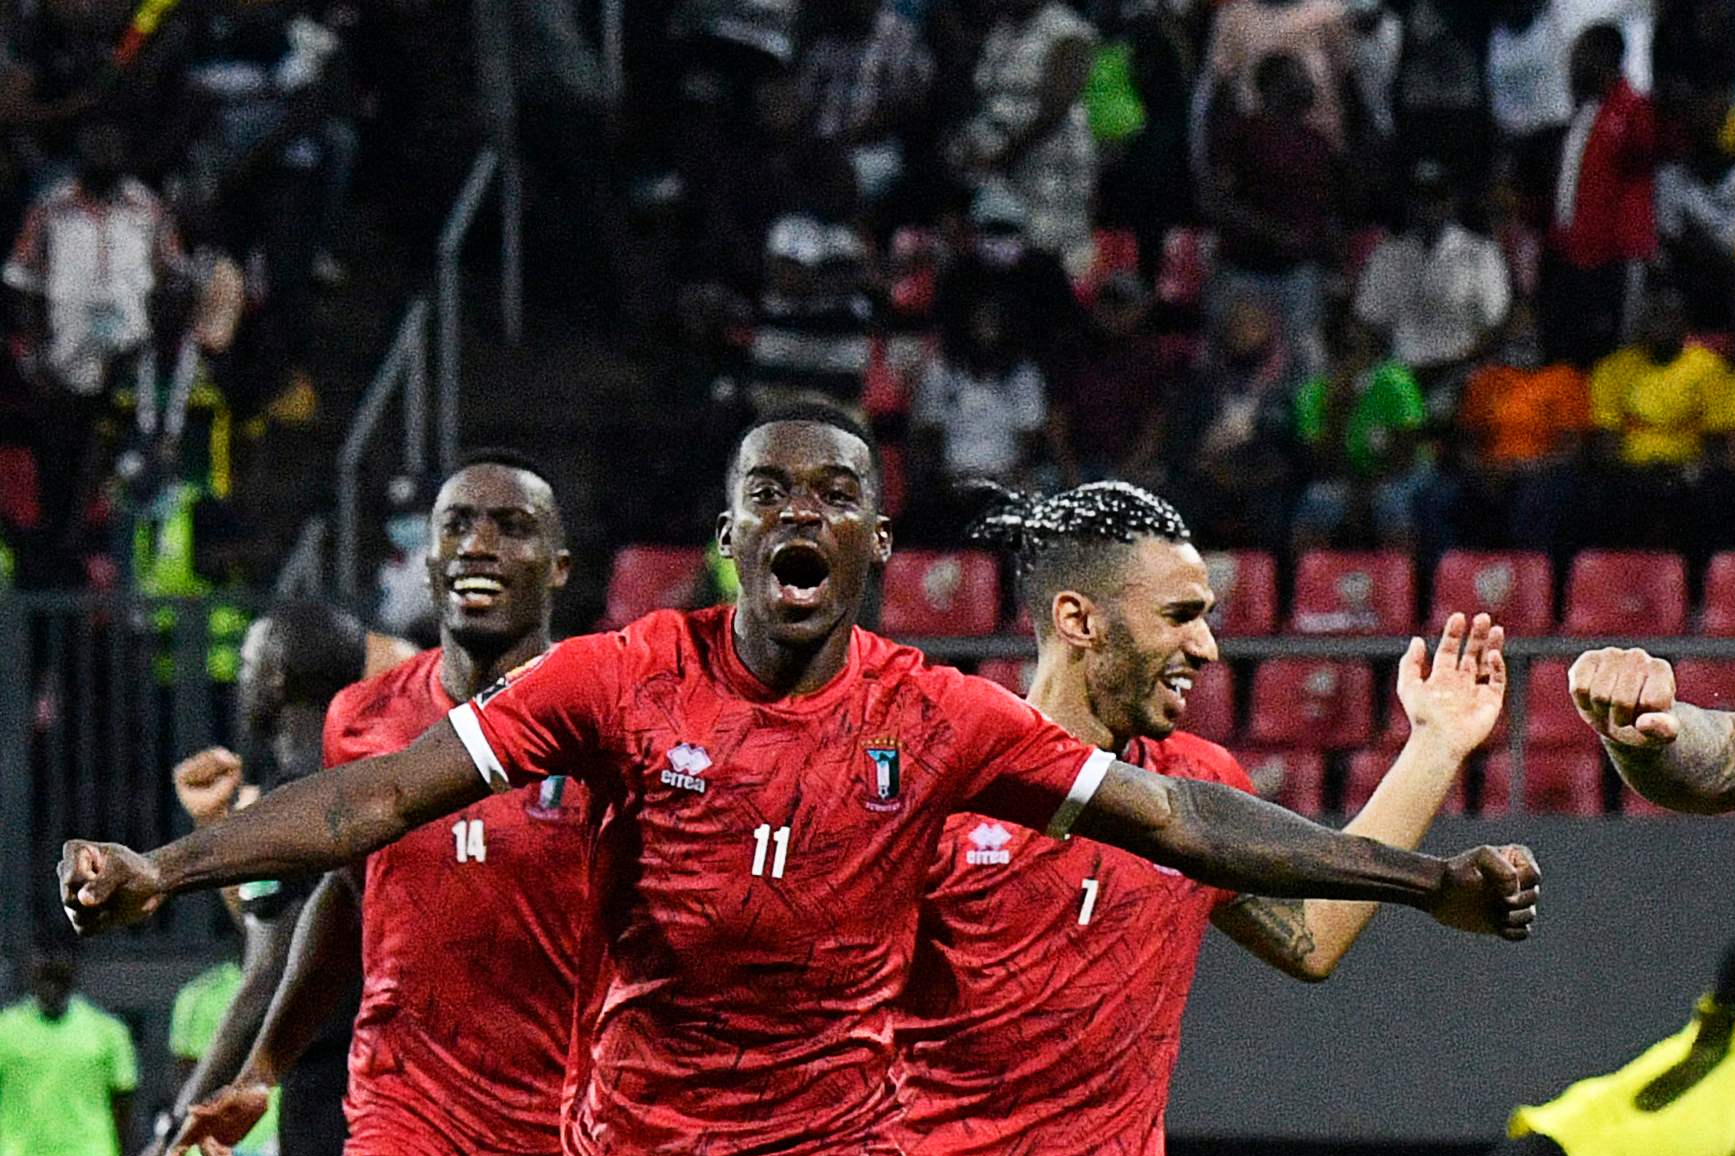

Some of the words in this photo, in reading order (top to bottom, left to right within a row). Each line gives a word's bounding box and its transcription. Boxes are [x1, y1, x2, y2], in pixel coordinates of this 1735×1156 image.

[660, 769, 706, 793] errea
[451, 820, 487, 863] 14
[751, 823, 791, 879] 11
[1078, 879, 1099, 925] 7
